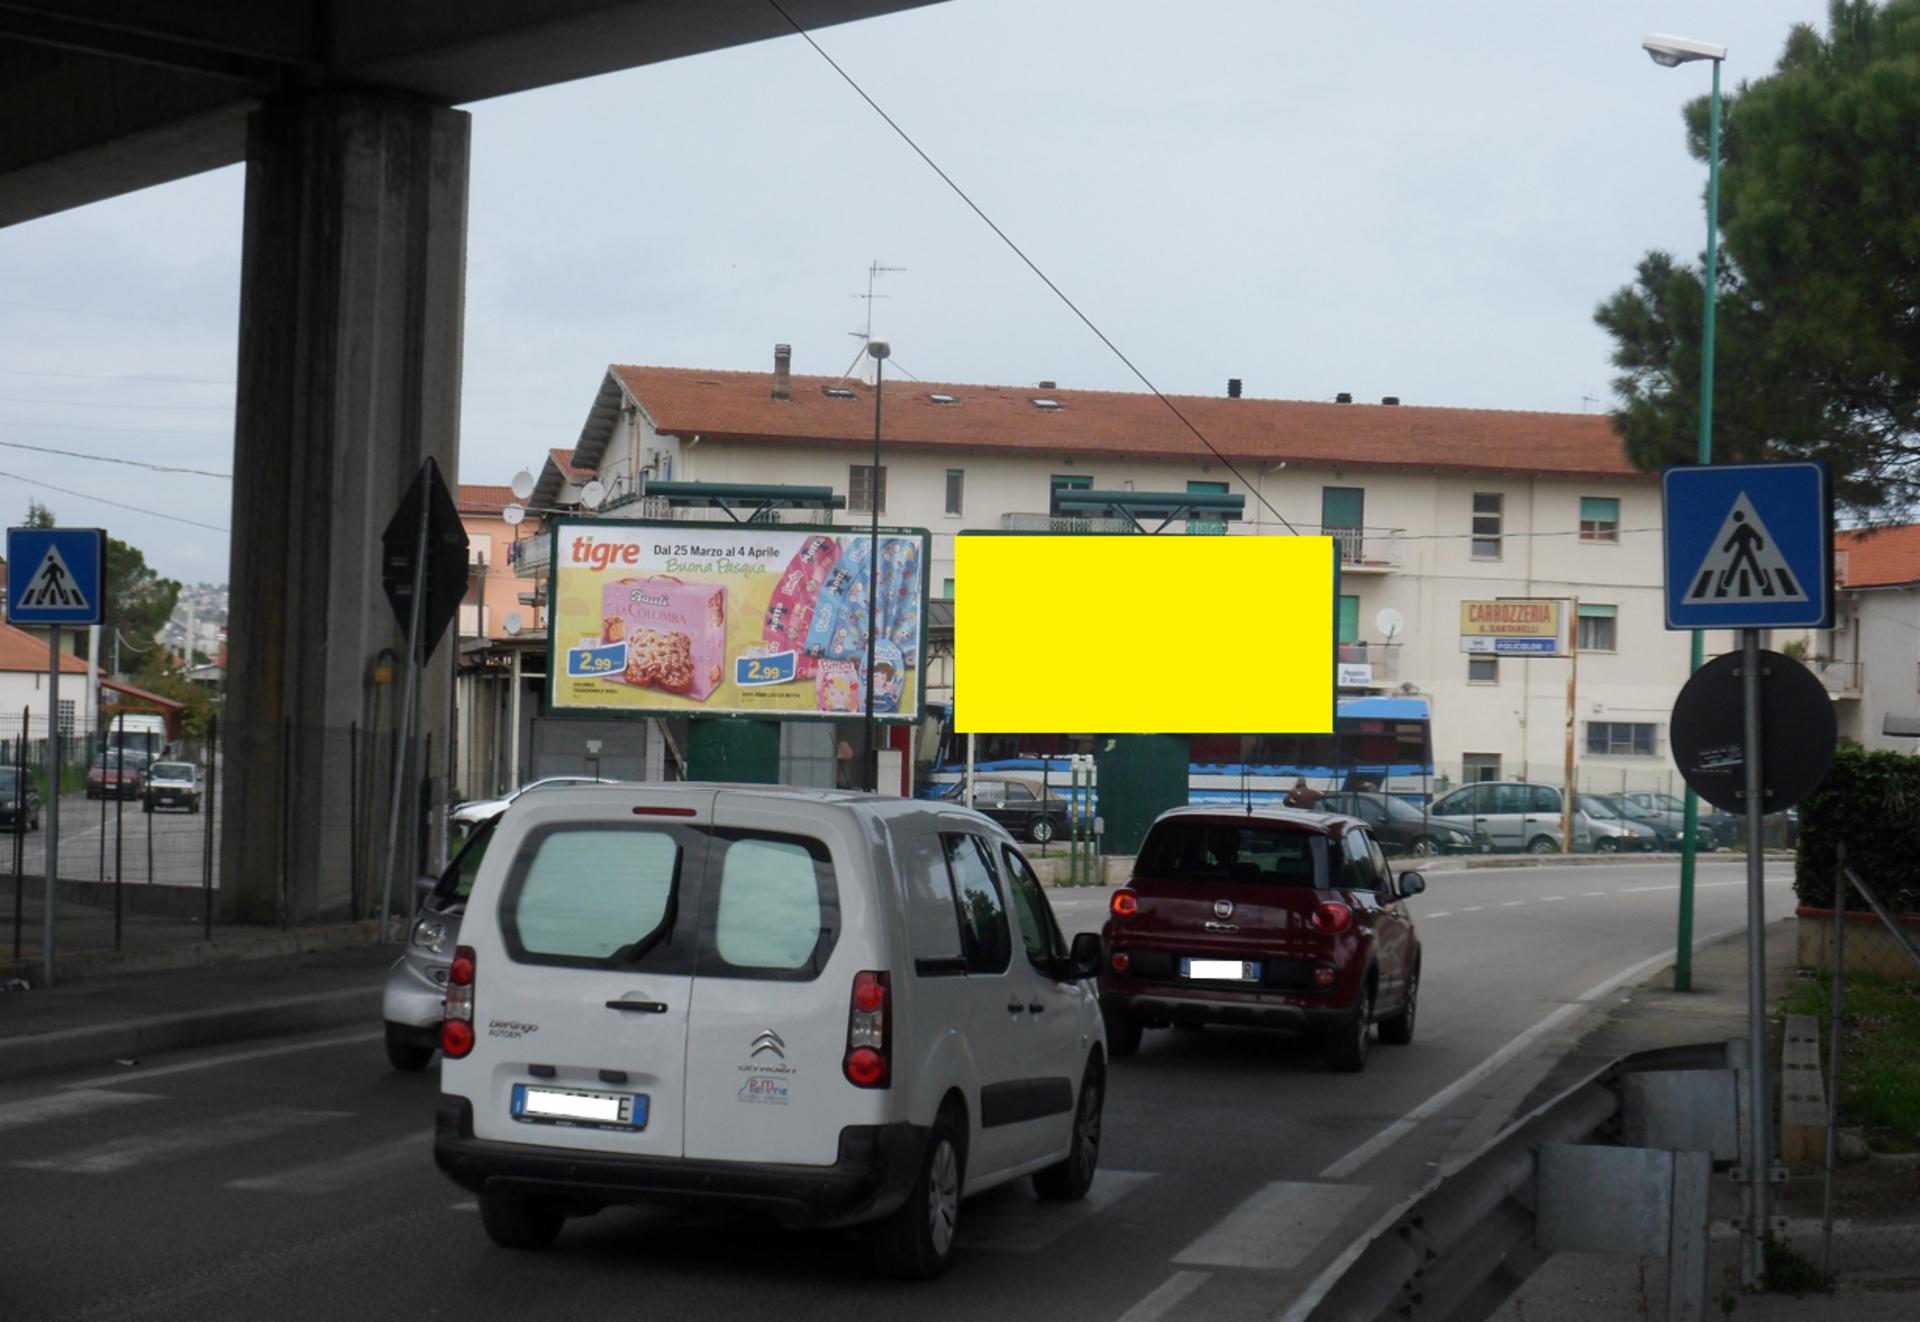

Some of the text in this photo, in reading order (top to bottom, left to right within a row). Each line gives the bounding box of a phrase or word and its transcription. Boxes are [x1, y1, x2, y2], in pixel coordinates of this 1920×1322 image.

[572, 536, 640, 571] tigre
[653, 544, 780, 559] Dal 25 Marzo al 4 Aprile
[665, 557, 766, 578] Buona Pasqua
[579, 652, 612, 671] 2,99
[747, 661, 780, 680] 2,99
